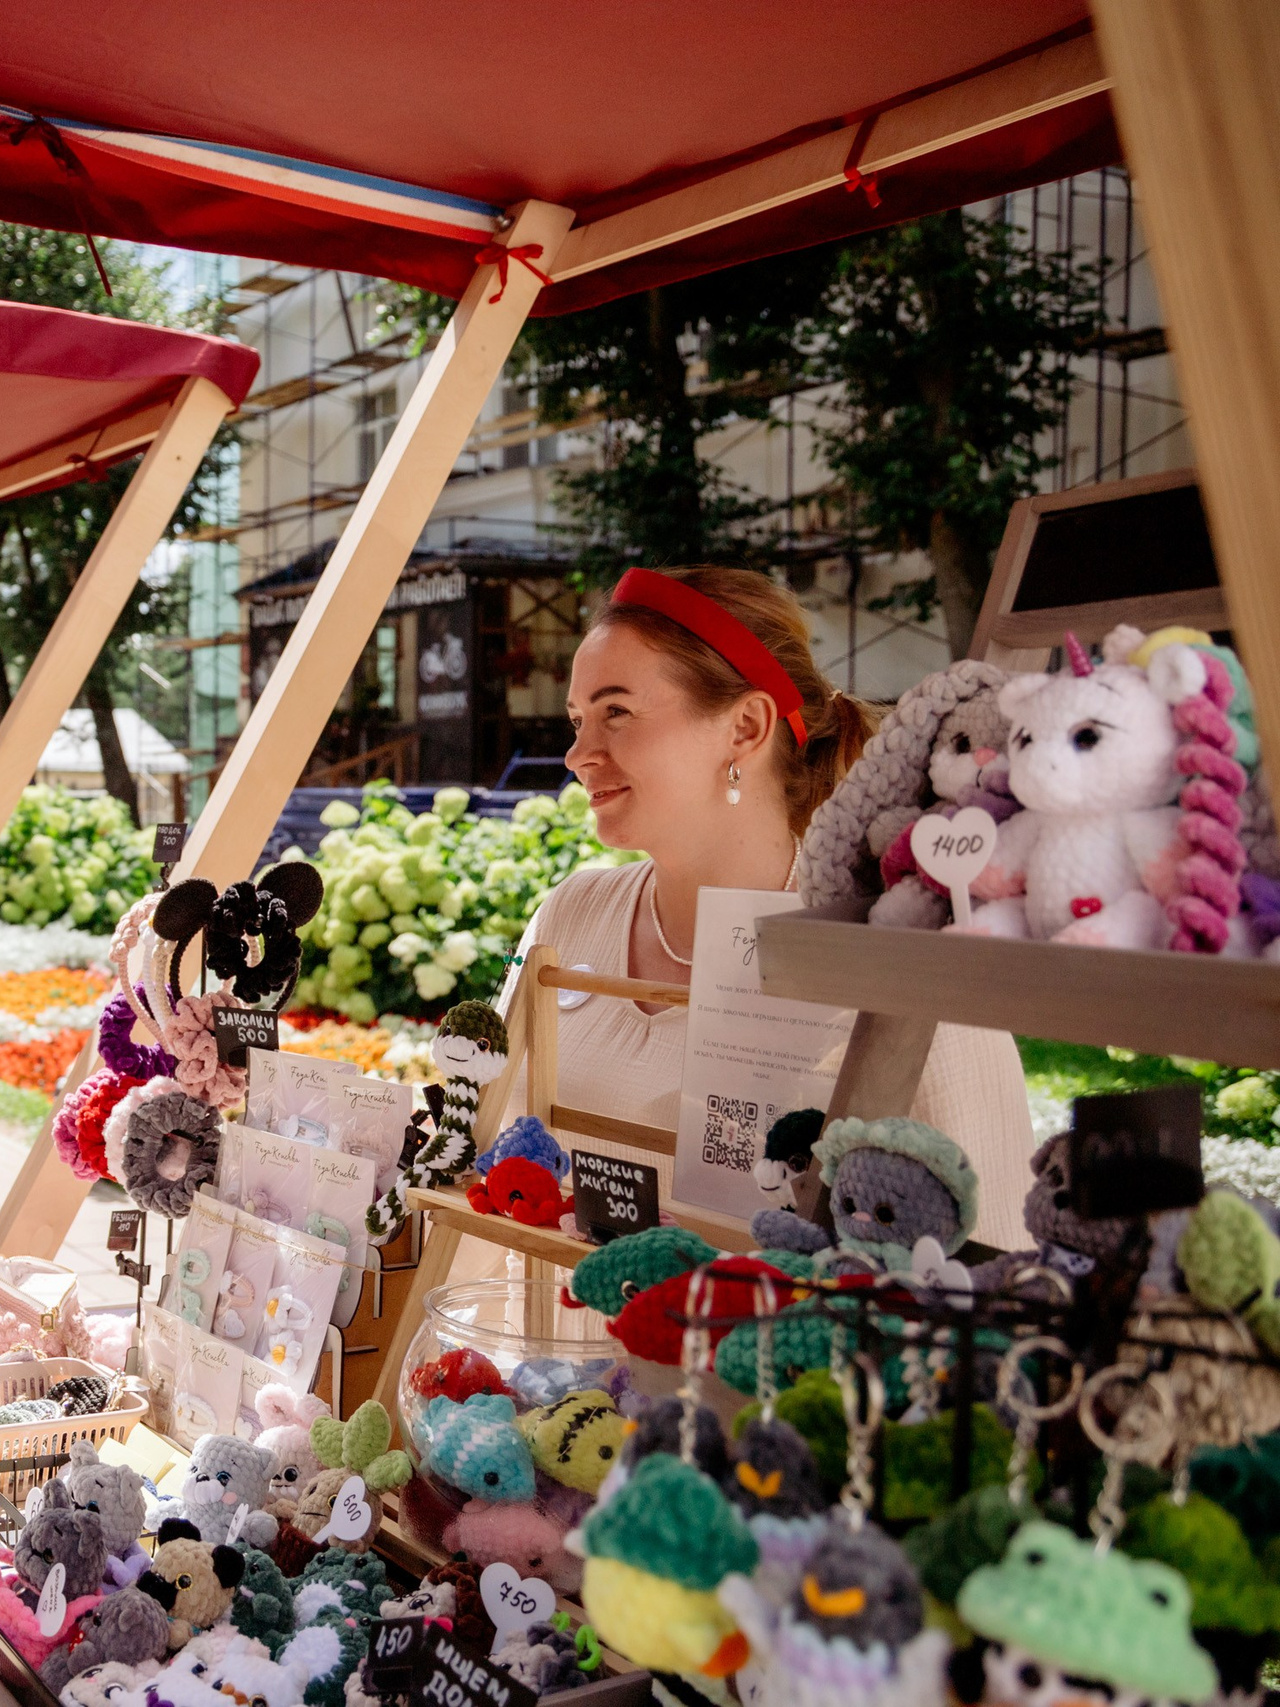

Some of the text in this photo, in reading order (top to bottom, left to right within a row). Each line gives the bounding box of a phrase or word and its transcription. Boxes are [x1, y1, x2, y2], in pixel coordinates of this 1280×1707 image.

[932, 834, 984, 858] 1400
[218, 1011, 275, 1031] ЗАКОЛКИ
[237, 1026, 268, 1043] 500
[606, 1196, 639, 1222] 300
[343, 1493, 362, 1522] 600
[499, 1581, 537, 1614] 750
[434, 1637, 511, 1707] ИЩЕМ
